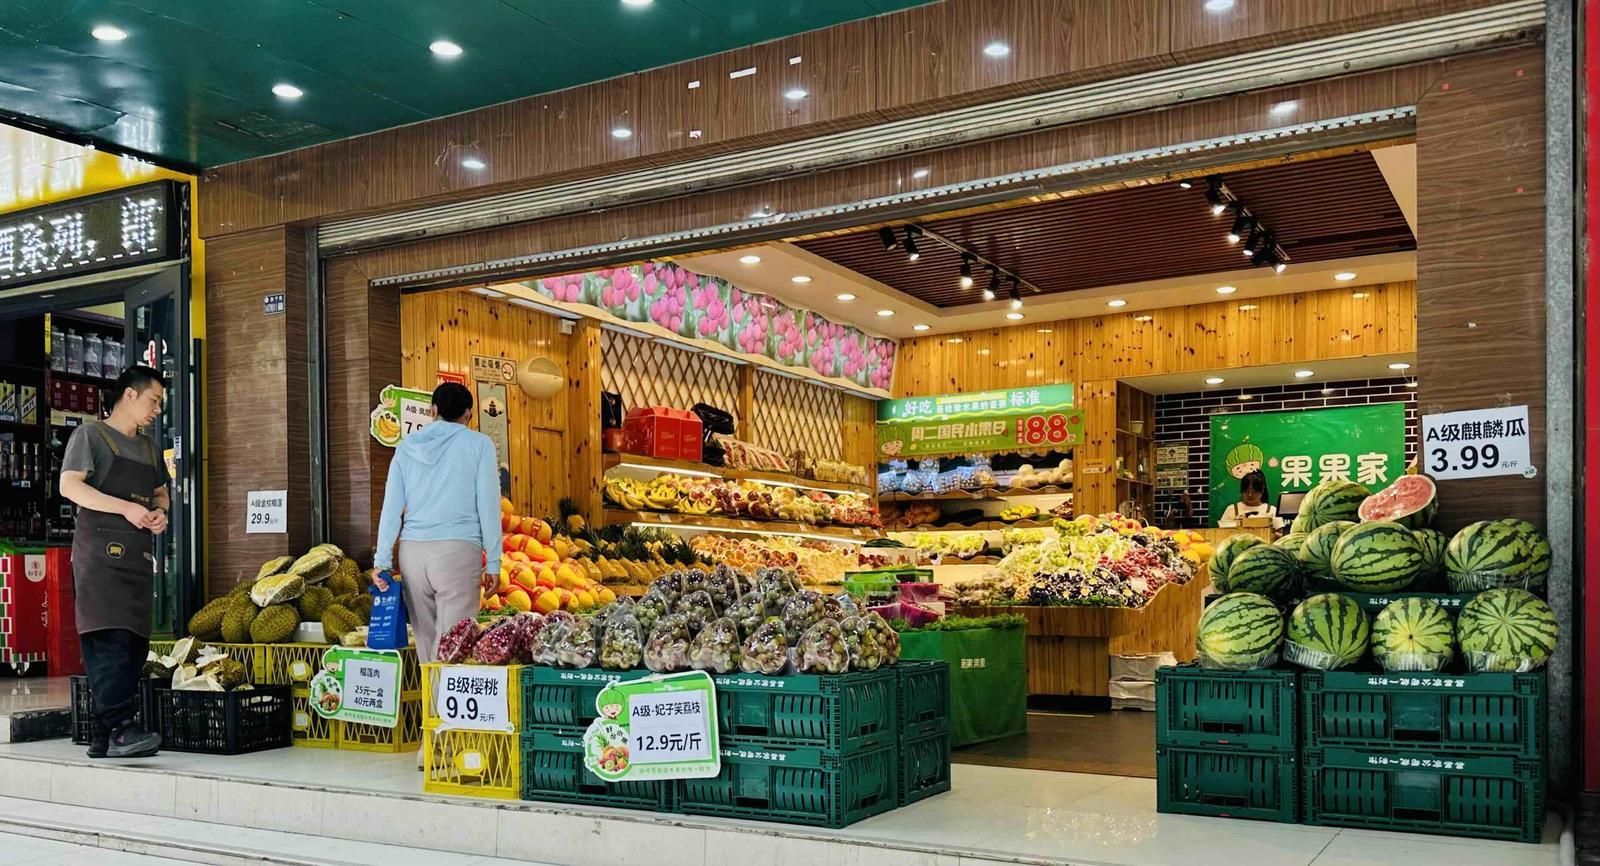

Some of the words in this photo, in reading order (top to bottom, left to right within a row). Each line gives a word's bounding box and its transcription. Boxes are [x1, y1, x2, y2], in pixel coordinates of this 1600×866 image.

[902, 400, 933, 417] 好吃
[1010, 390, 1041, 407] 标准
[911, 421, 1006, 442] 周二国民水果日
[1025, 413, 1069, 445] 88
[1426, 418, 1526, 442] A级麒麟瓜
[1431, 443, 1500, 472] 3.99
[1502, 460, 1518, 469] 元/斤
[1281, 452, 1388, 487] 果果家
[251, 513, 270, 524] 29.9
[359, 667, 380, 678] 榴莲肉
[355, 685, 384, 698] 25元一盒
[447, 677, 498, 696] B级樱桃
[353, 697, 383, 709] 40元两盒
[446, 697, 478, 720] 9.9
[632, 701, 701, 717] A级-妃子笑荔枝
[636, 732, 702, 752] 12.9元/斤
